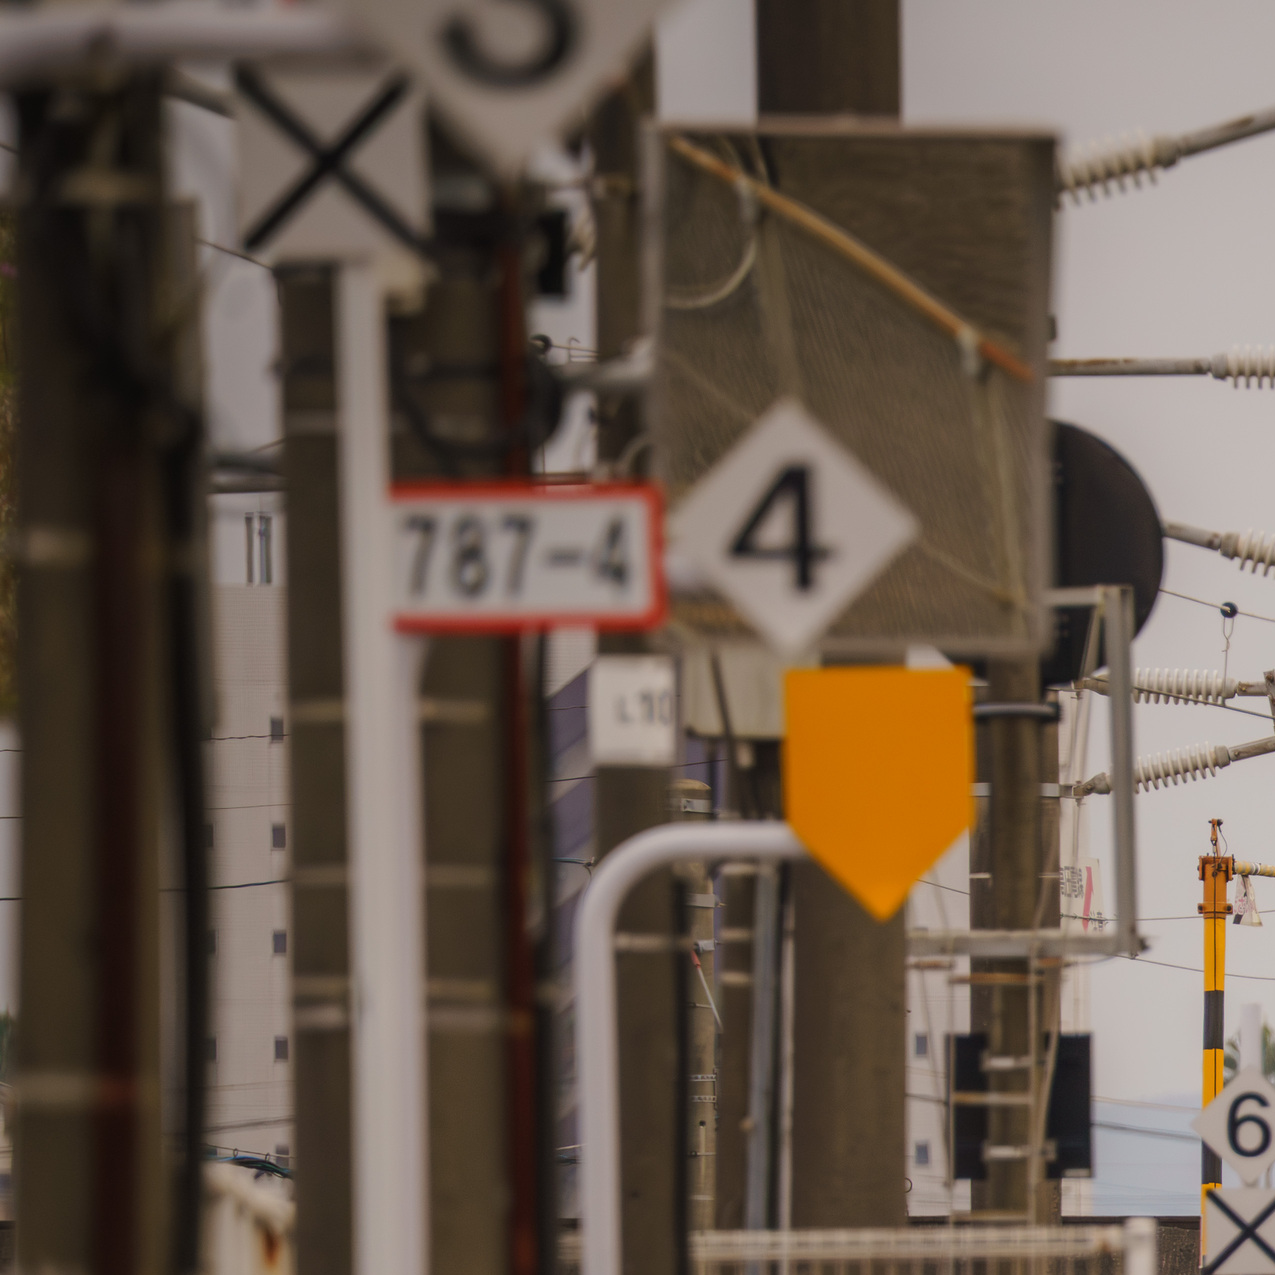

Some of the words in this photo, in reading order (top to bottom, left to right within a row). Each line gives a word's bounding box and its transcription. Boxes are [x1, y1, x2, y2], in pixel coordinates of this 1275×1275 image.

[400, 515, 631, 600] 787-4
[728, 461, 832, 593] 4
[1226, 1091, 1272, 1158] 6
